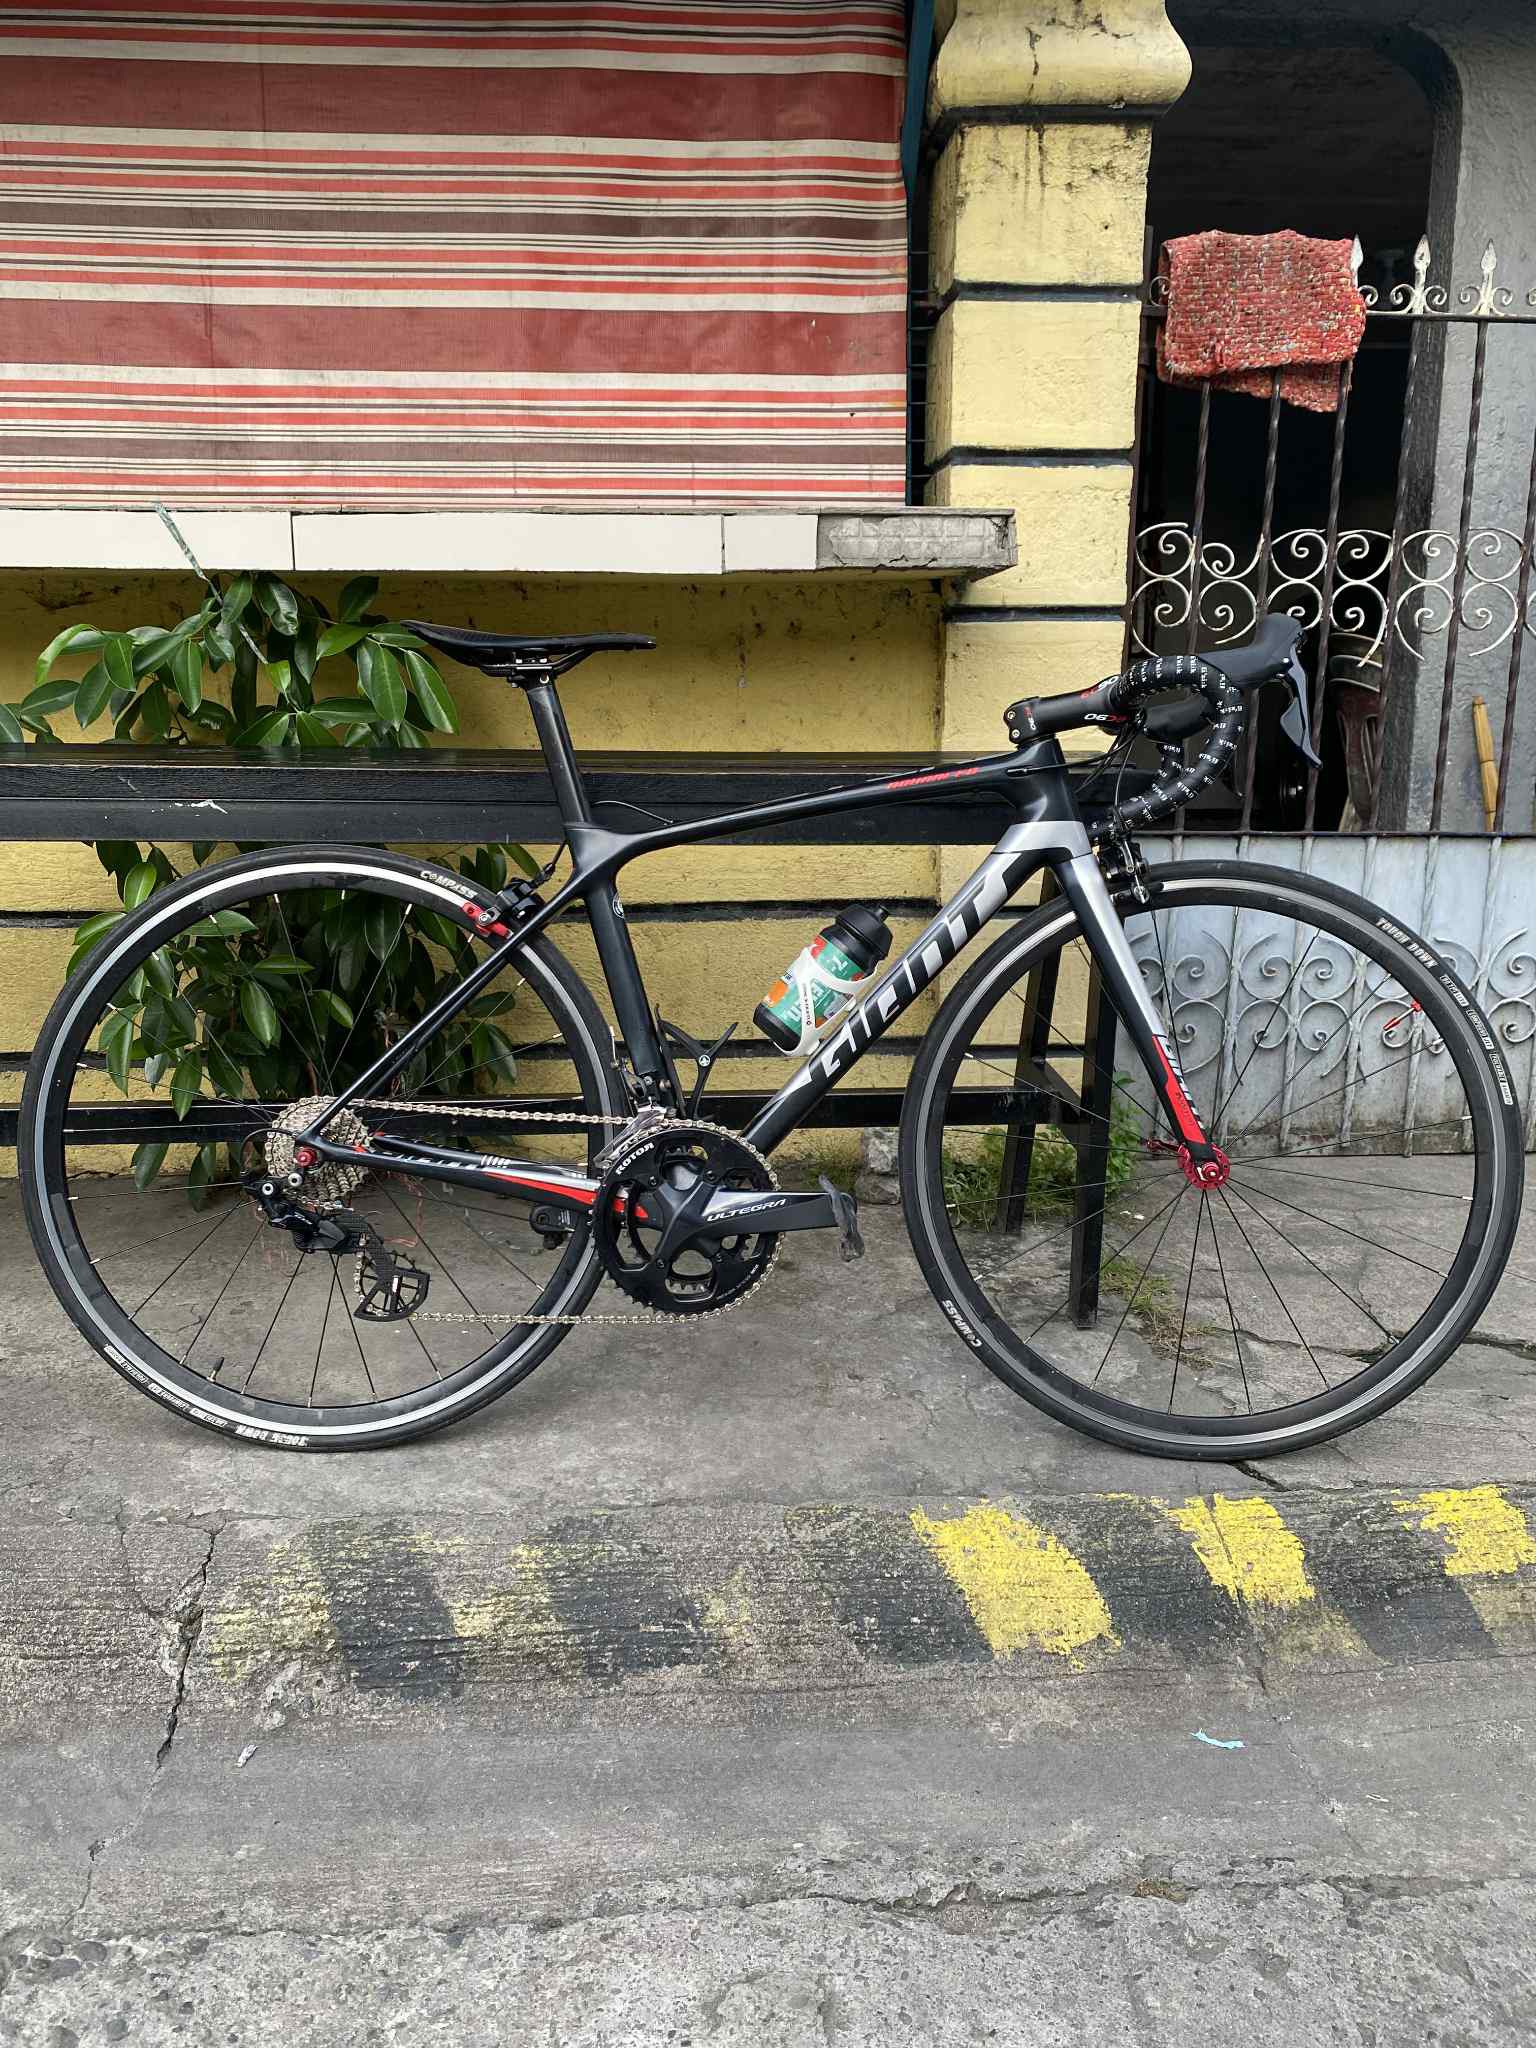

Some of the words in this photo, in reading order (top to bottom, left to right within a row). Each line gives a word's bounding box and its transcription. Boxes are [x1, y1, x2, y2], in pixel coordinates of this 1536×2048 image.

[420, 870, 478, 898] COMPASS
[615, 1142, 654, 1175] ROTOR
[706, 1197, 786, 1222] ULTEGRA
[942, 1300, 982, 1347] COMPASS
